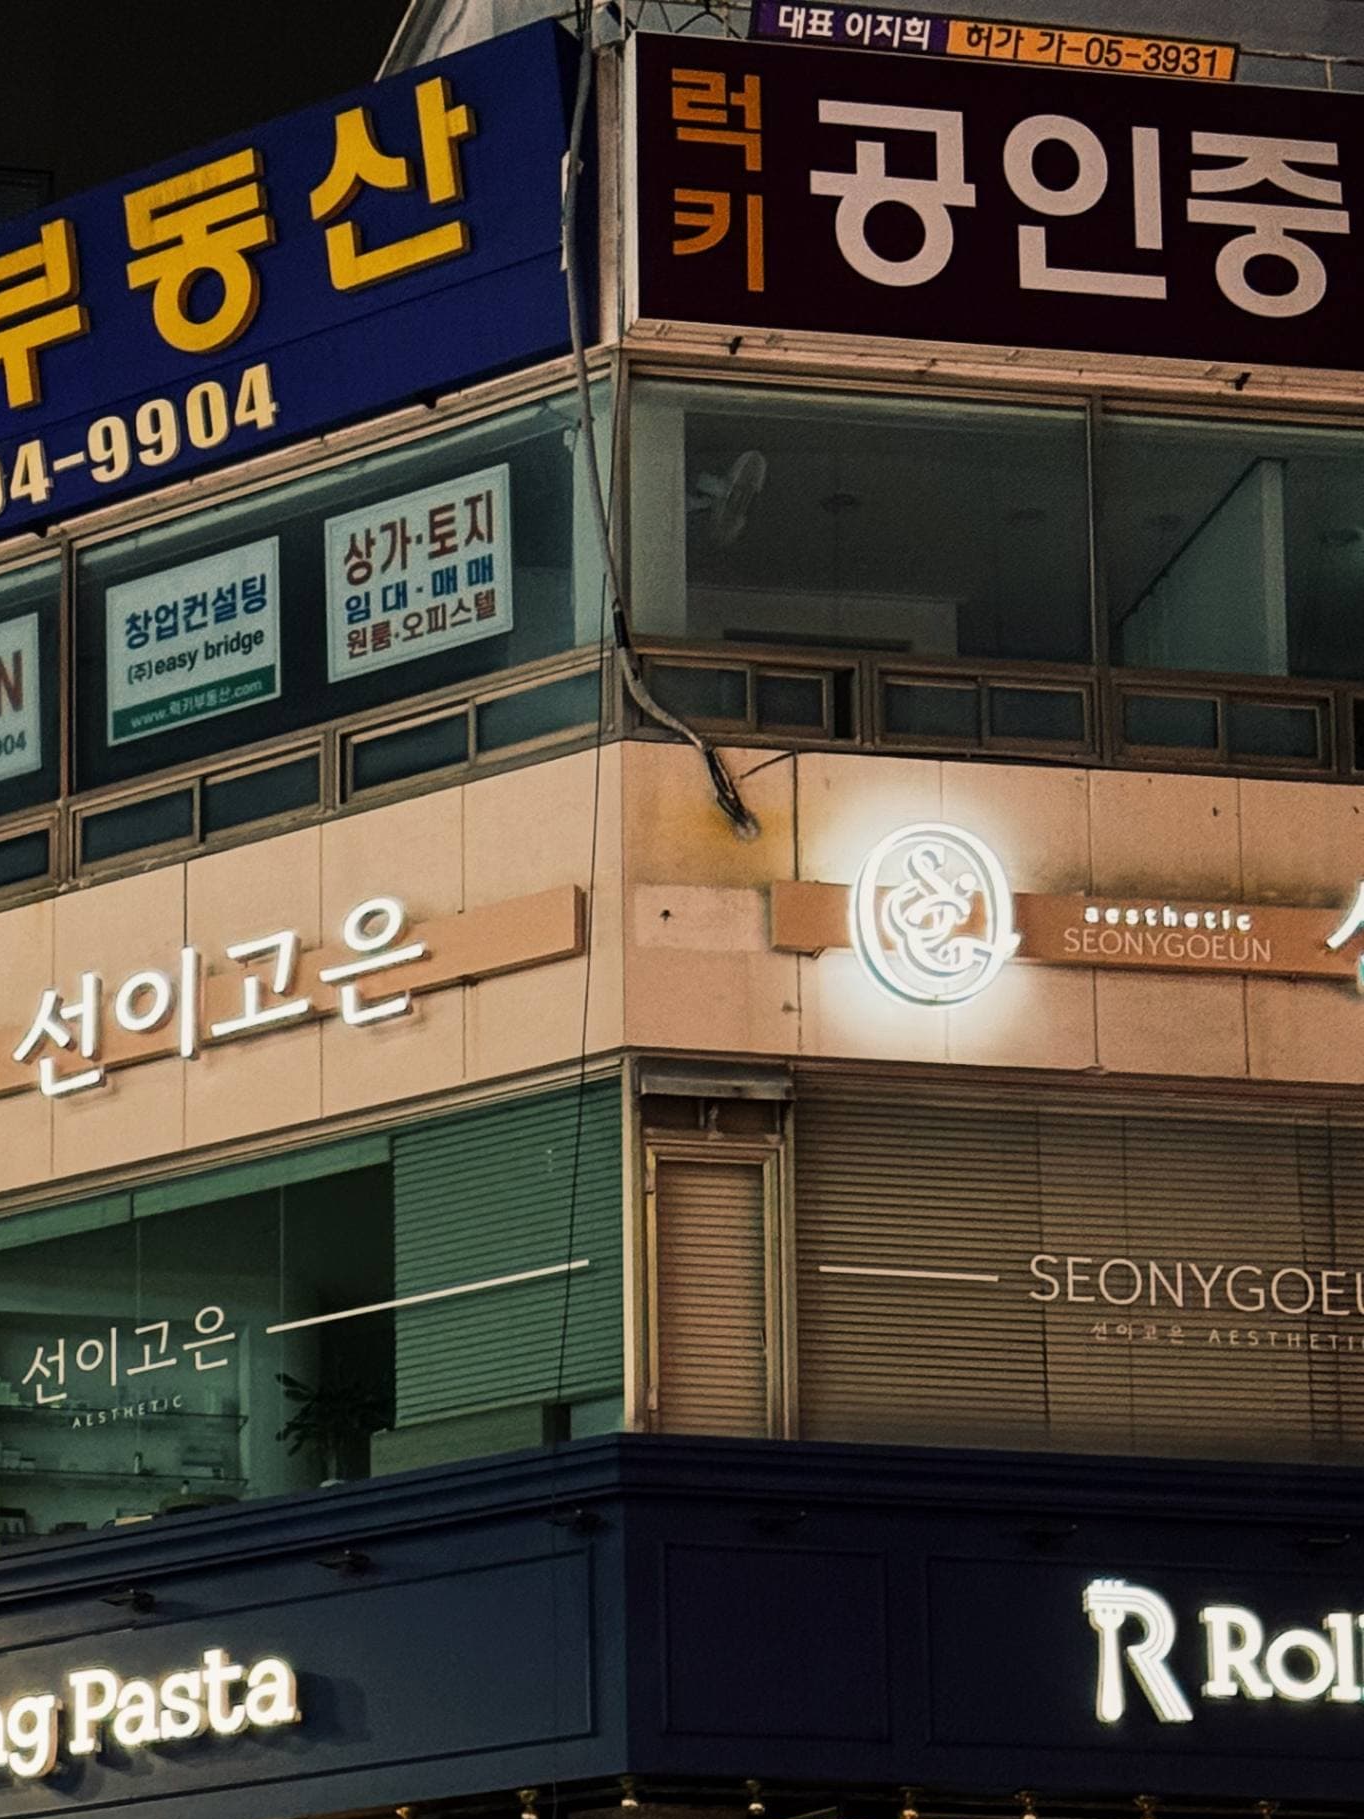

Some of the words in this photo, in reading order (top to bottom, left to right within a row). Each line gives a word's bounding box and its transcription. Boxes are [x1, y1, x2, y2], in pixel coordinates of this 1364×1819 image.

[777, 5, 835, 40] 대표
[844, 10, 932, 51] 이지희
[965, 23, 1025, 60] 허가
[1036, 30, 1221, 78] 가-05-3931
[670, 66, 766, 294] 럭키
[809, 97, 1351, 320] 공인중
[124, 573, 268, 651] 창업컨설팅
[203, 626, 266, 662] bridge
[1063, 927, 1272, 963] SEONYGOEUN
[1084, 904, 1253, 932] aesthetic
[12, 896, 428, 1099] 선이고은
[1029, 1253, 1364, 1317] SEONYGOE
[22, 1305, 236, 1405] 선이고은
[1090, 1320, 1186, 1345] 선이고은
[1208, 1329, 1364, 1351] AESTHETI
[72, 1394, 184, 1430] AESTHETIC
[1199, 1602, 1364, 1703] Rol
[68, 1648, 301, 1755] Pasta
